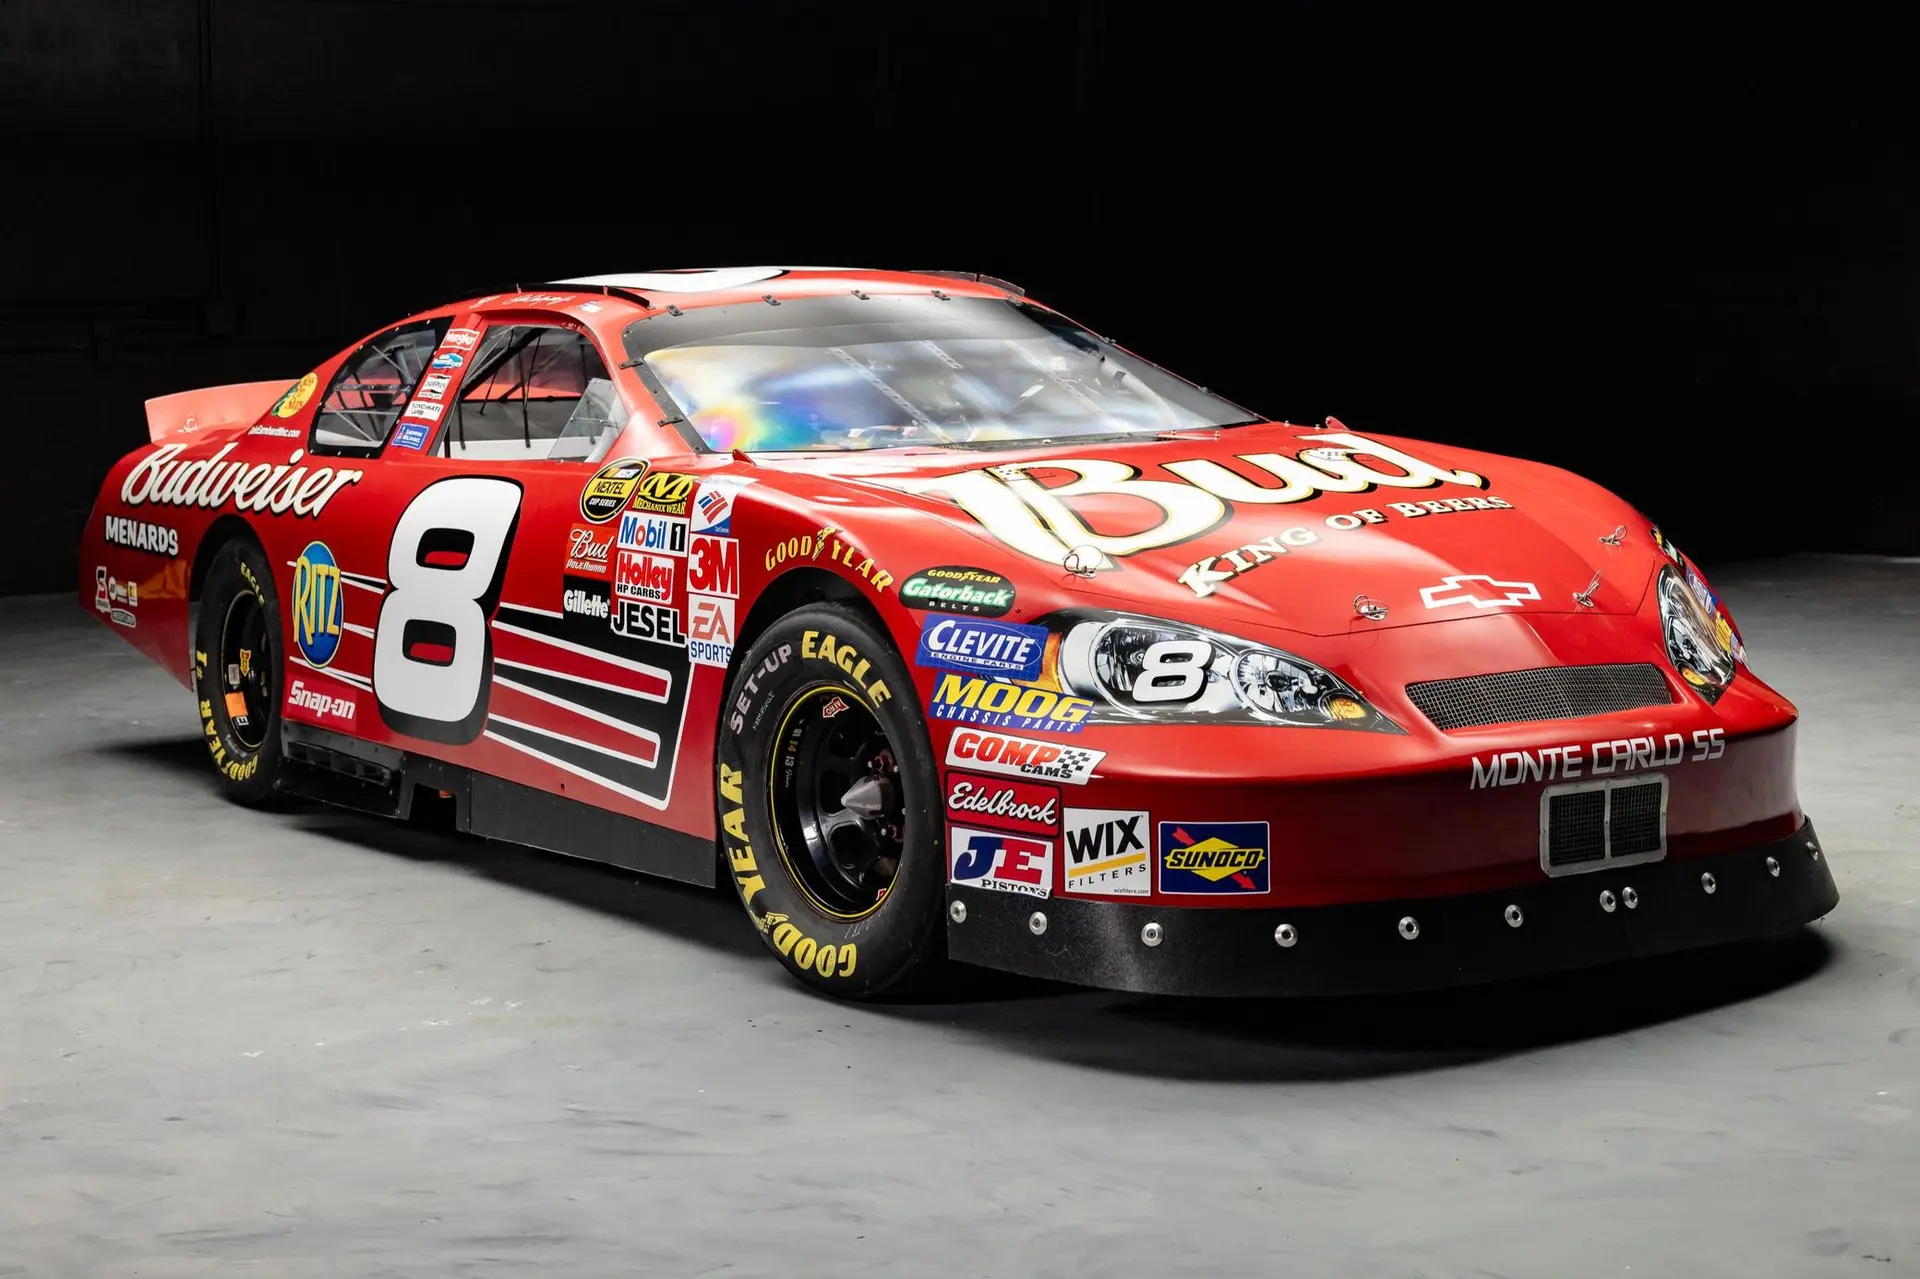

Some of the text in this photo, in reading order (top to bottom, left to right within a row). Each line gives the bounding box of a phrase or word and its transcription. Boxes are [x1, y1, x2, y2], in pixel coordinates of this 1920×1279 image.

[121, 442, 364, 517] Budweiser
[593, 481, 625, 495] NEXTEL
[589, 497, 617, 508] CUP SERIES
[632, 496, 686, 515] MECHANIX WEAR
[890, 434, 1490, 569] Bud
[105, 514, 179, 556] MENARDS
[570, 528, 615, 560] Bud
[620, 515, 667, 550] Mobil
[1177, 496, 1514, 597] KING OF BEERS
[240, 561, 265, 606] EAGLE
[617, 552, 672, 601] Holley
[690, 537, 738, 595] 3M
[927, 569, 1001, 584] GOODYEAR
[293, 555, 341, 646] RITZ
[374, 477, 522, 746] 8
[563, 589, 609, 619] Gillette
[616, 583, 661, 600] HP CARBS
[902, 577, 1012, 608] Gatorback
[928, 601, 980, 613] BELTS
[612, 600, 687, 646] JESEL
[691, 601, 731, 645] EA
[928, 619, 1036, 663] CLEVITE
[690, 640, 734, 665] SPORTS
[801, 630, 892, 709] EAGLE
[930, 652, 1025, 671] ENGINE PARTS
[1131, 640, 1215, 702] 8
[288, 681, 357, 720] Snap-on
[729, 643, 793, 735] SET-UP
[825, 699, 842, 715] AERO
[932, 673, 1094, 724] MOOG
[936, 704, 1077, 733] CHASSIS PARTS
[953, 732, 1062, 767] COMP
[1470, 727, 1726, 790] MONTE CARLO SS
[1020, 763, 1074, 780] CAMS
[948, 782, 1058, 825] Edelbrock
[1066, 815, 1145, 865] WIX
[1166, 850, 1263, 869] SUNOCO
[953, 835, 1047, 886] JE
[1068, 863, 1147, 889] FILTERS
[981, 878, 1048, 898] PISTONS
